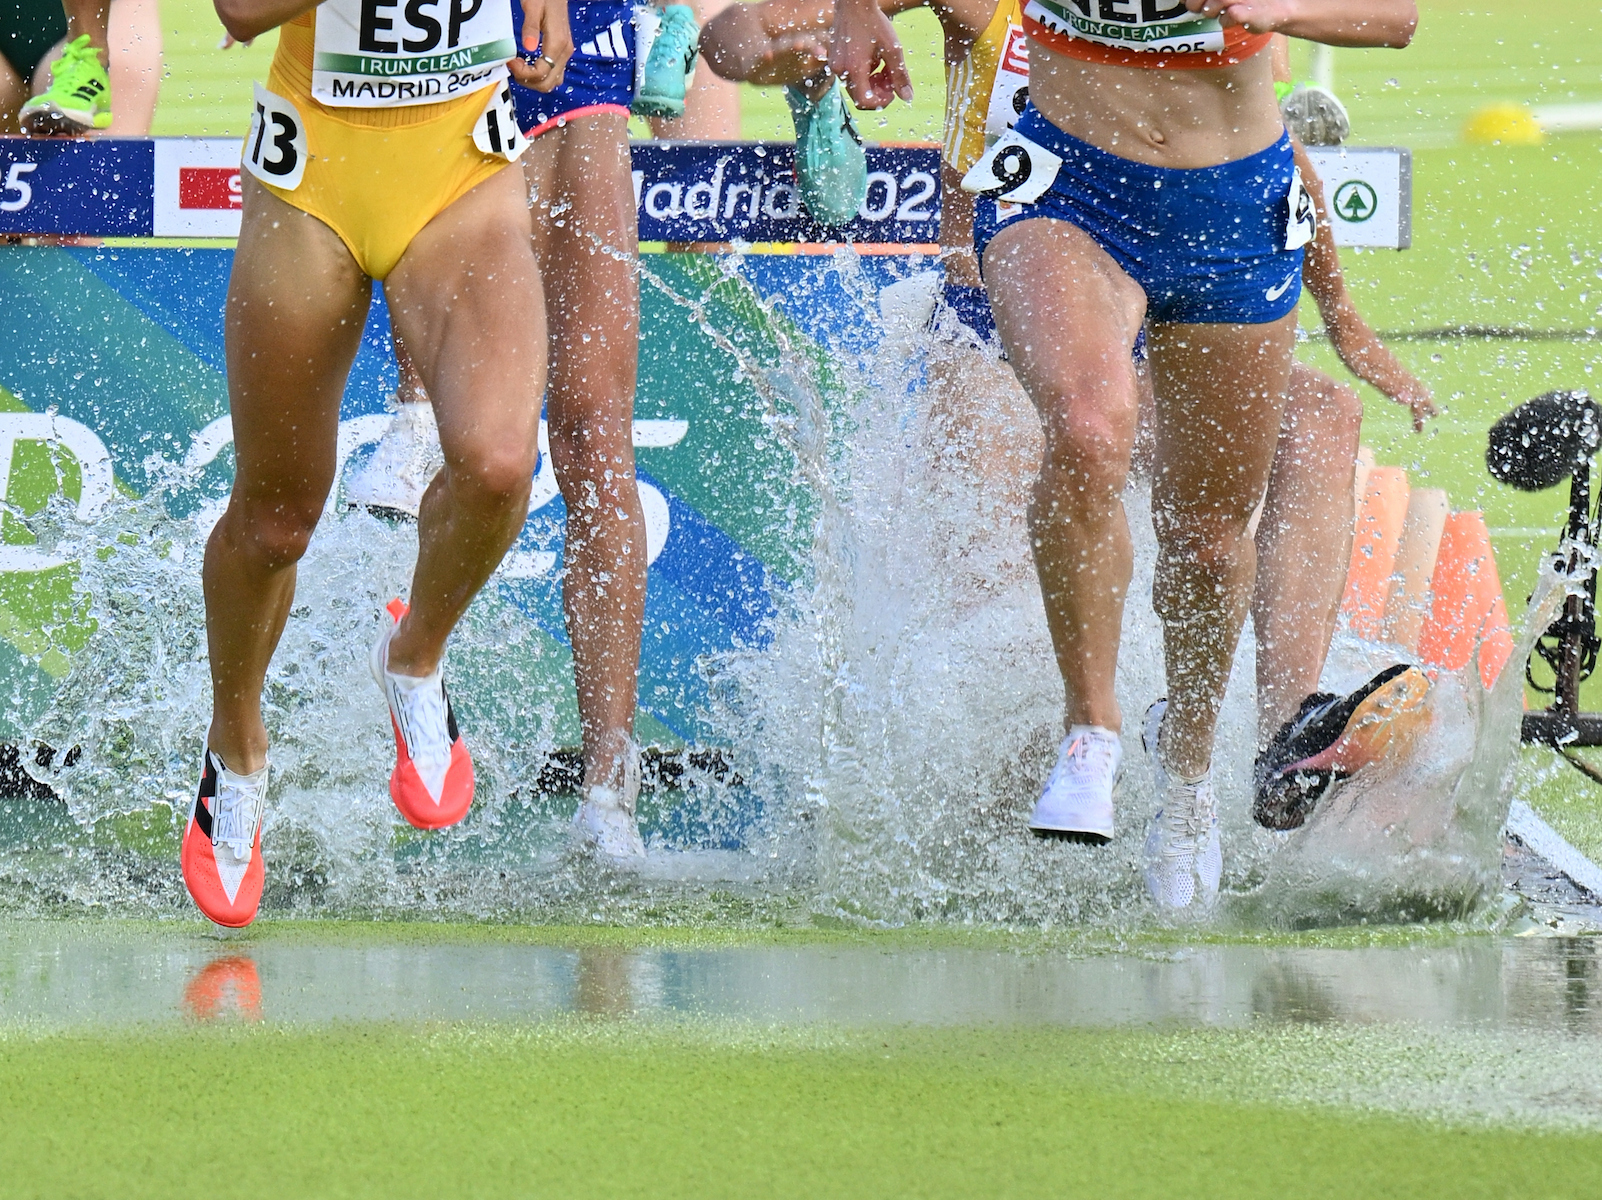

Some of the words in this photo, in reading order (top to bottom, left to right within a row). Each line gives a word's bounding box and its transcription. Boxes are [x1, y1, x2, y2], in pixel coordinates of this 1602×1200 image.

[1068, 10, 1101, 34] RUN
[370, 59, 412, 75] RUN
[332, 79, 441, 99] MADRID
[252, 100, 298, 176] 13
[979, 145, 1032, 199] 9
